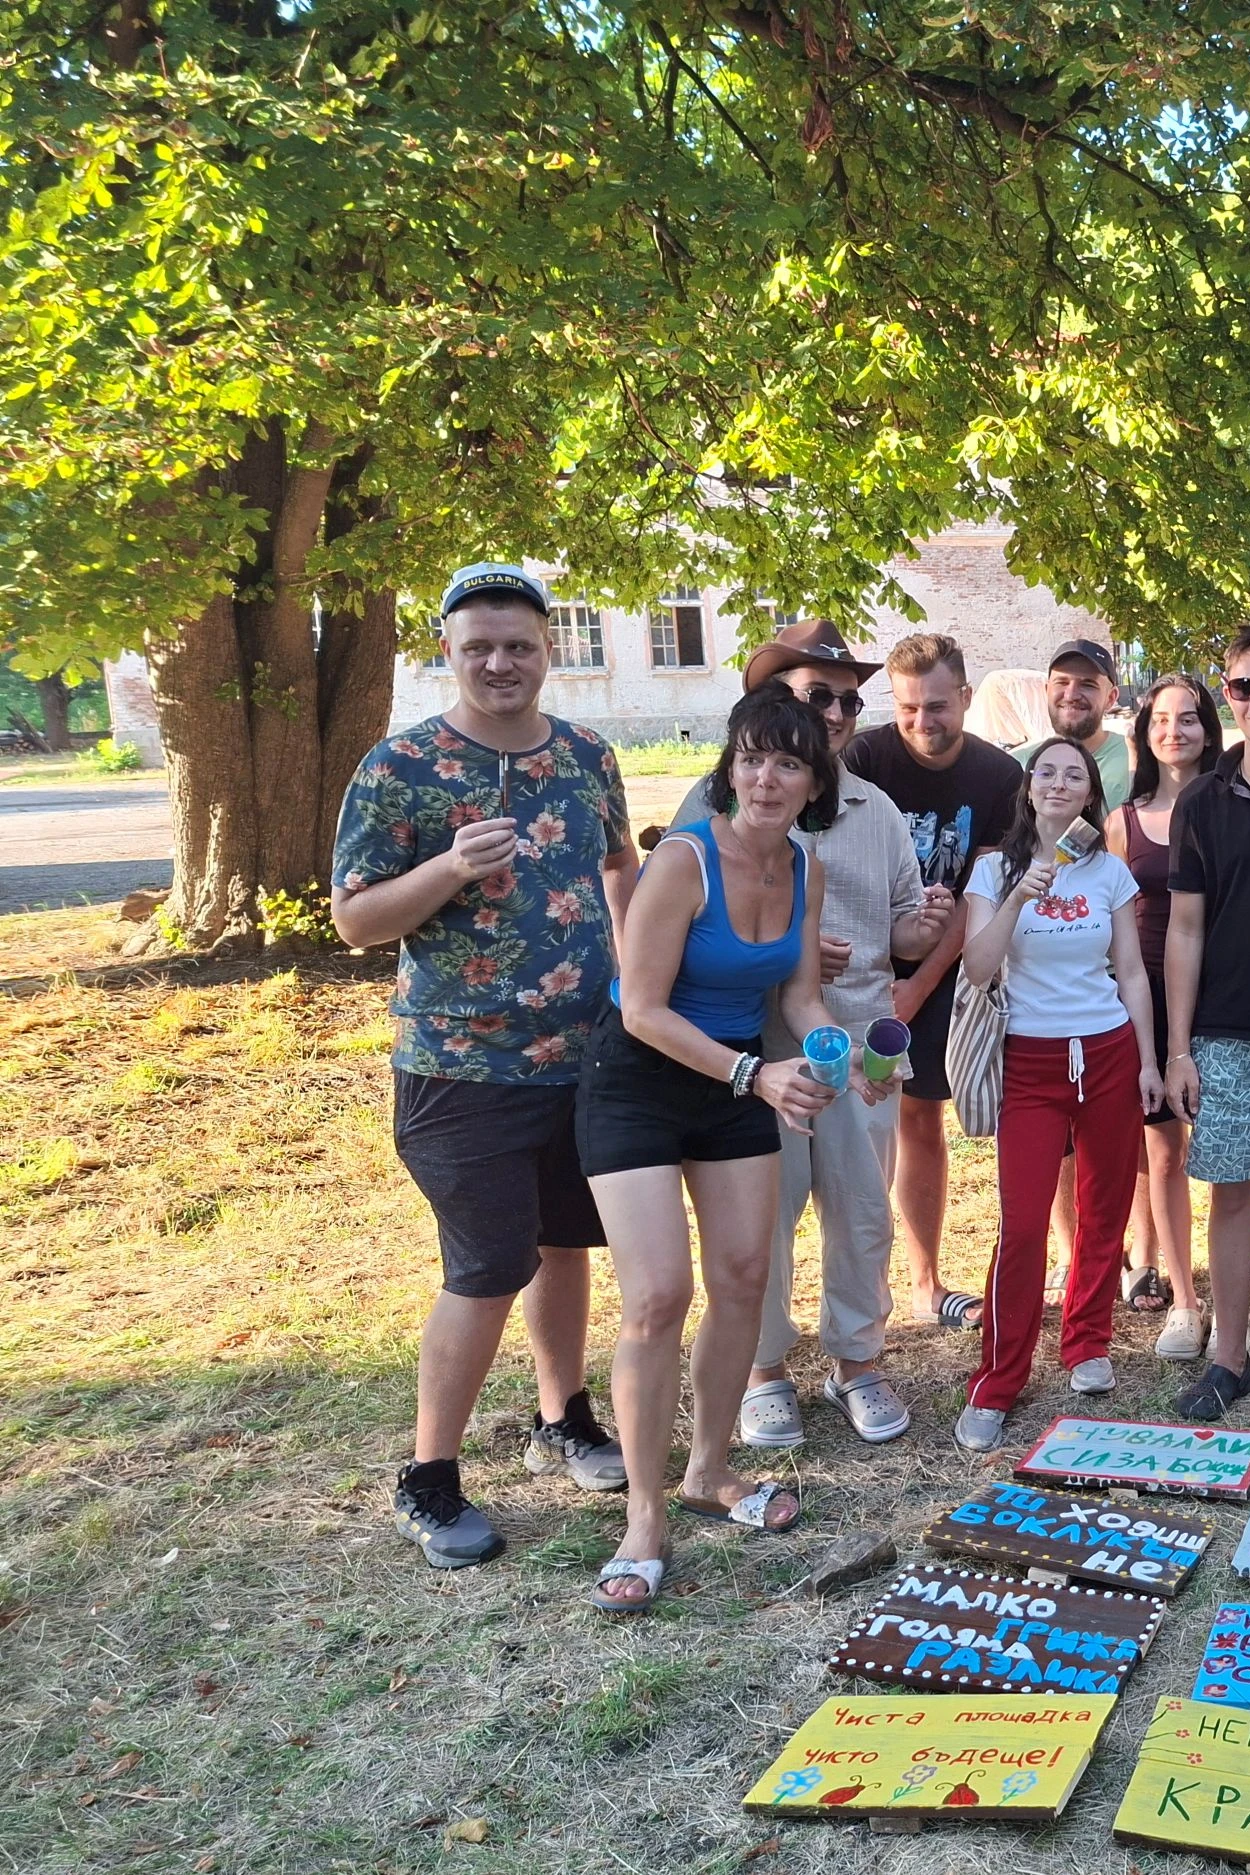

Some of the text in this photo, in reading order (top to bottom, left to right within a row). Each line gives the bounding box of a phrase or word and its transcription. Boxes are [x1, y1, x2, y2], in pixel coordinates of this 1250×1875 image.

[463, 575, 525, 588] BULGARIA
[897, 1576, 1057, 1618] МАЛКО
[833, 1706, 1093, 1727] Чиста площадка
[911, 1745, 1065, 1768] бъдеще!
